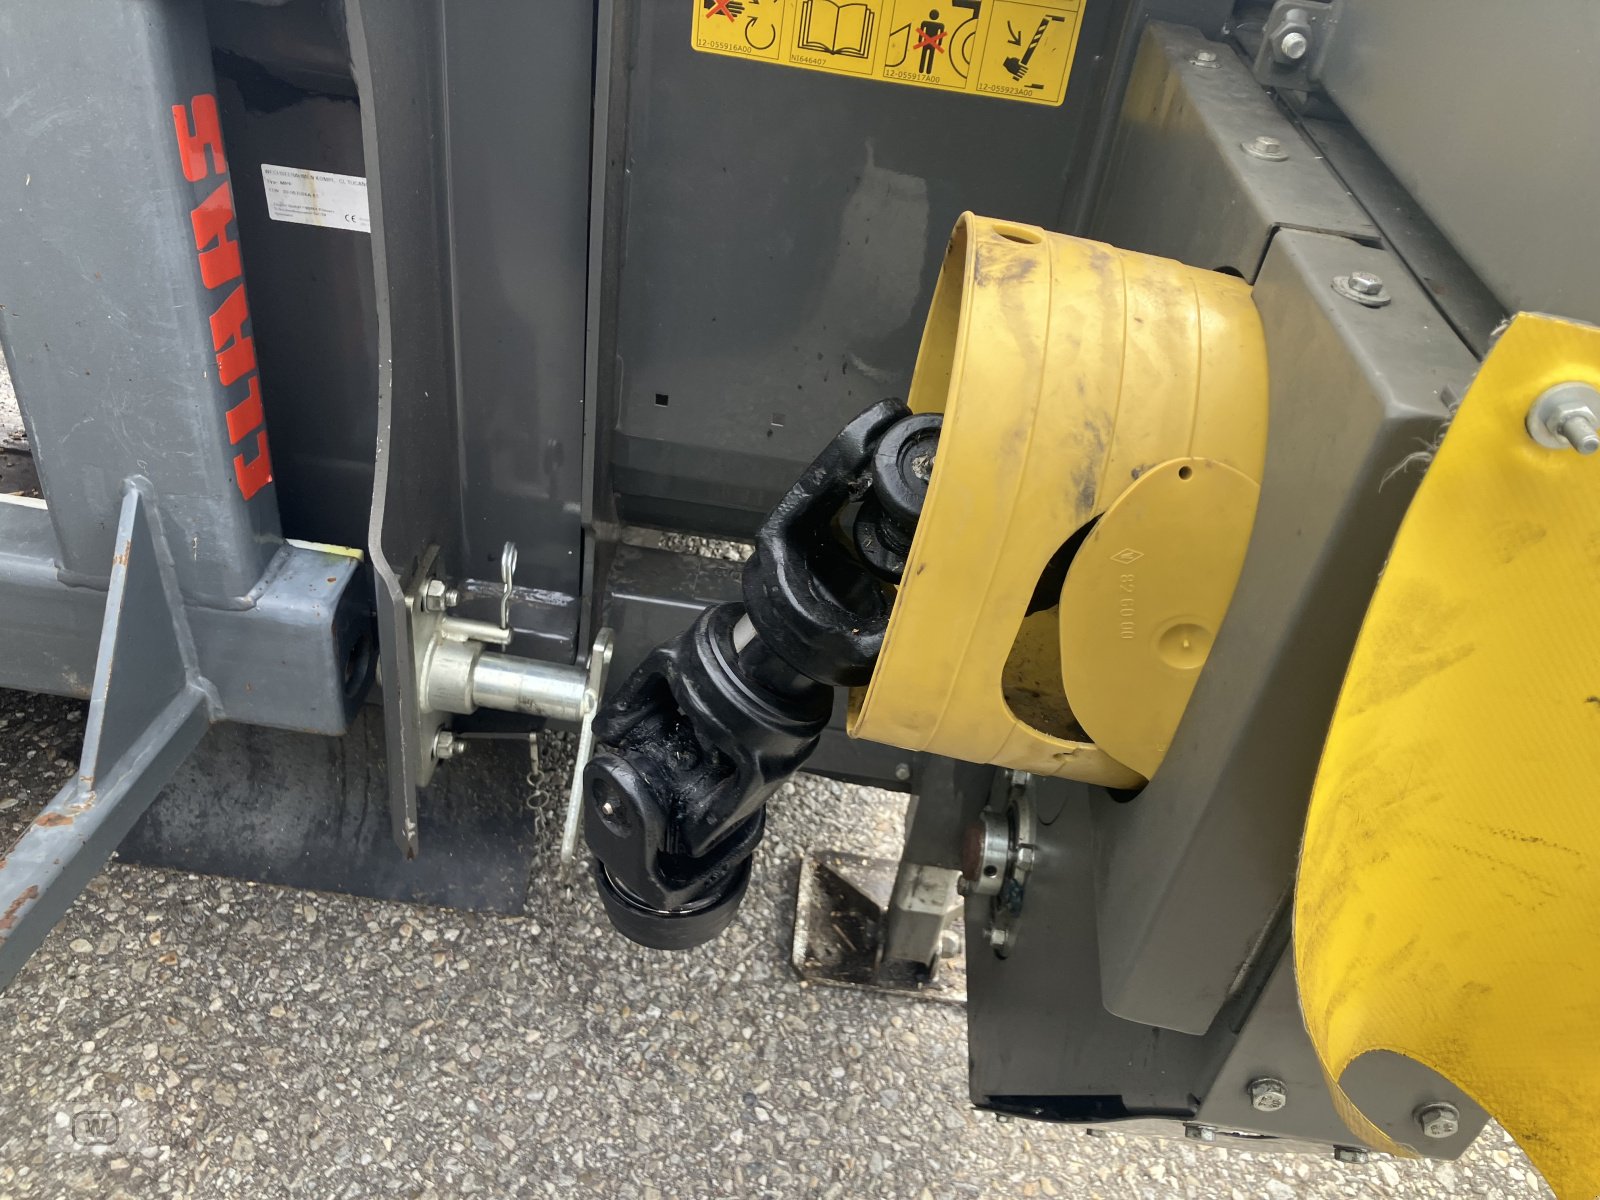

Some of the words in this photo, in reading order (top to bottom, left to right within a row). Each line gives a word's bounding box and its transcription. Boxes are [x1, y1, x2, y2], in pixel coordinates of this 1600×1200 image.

[698, 38, 752, 54] 12-055916A00
[885, 69, 940, 84] 12-055917A00
[979, 82, 1033, 97] 12-055923A00
[172, 93, 274, 501] CLAAS
